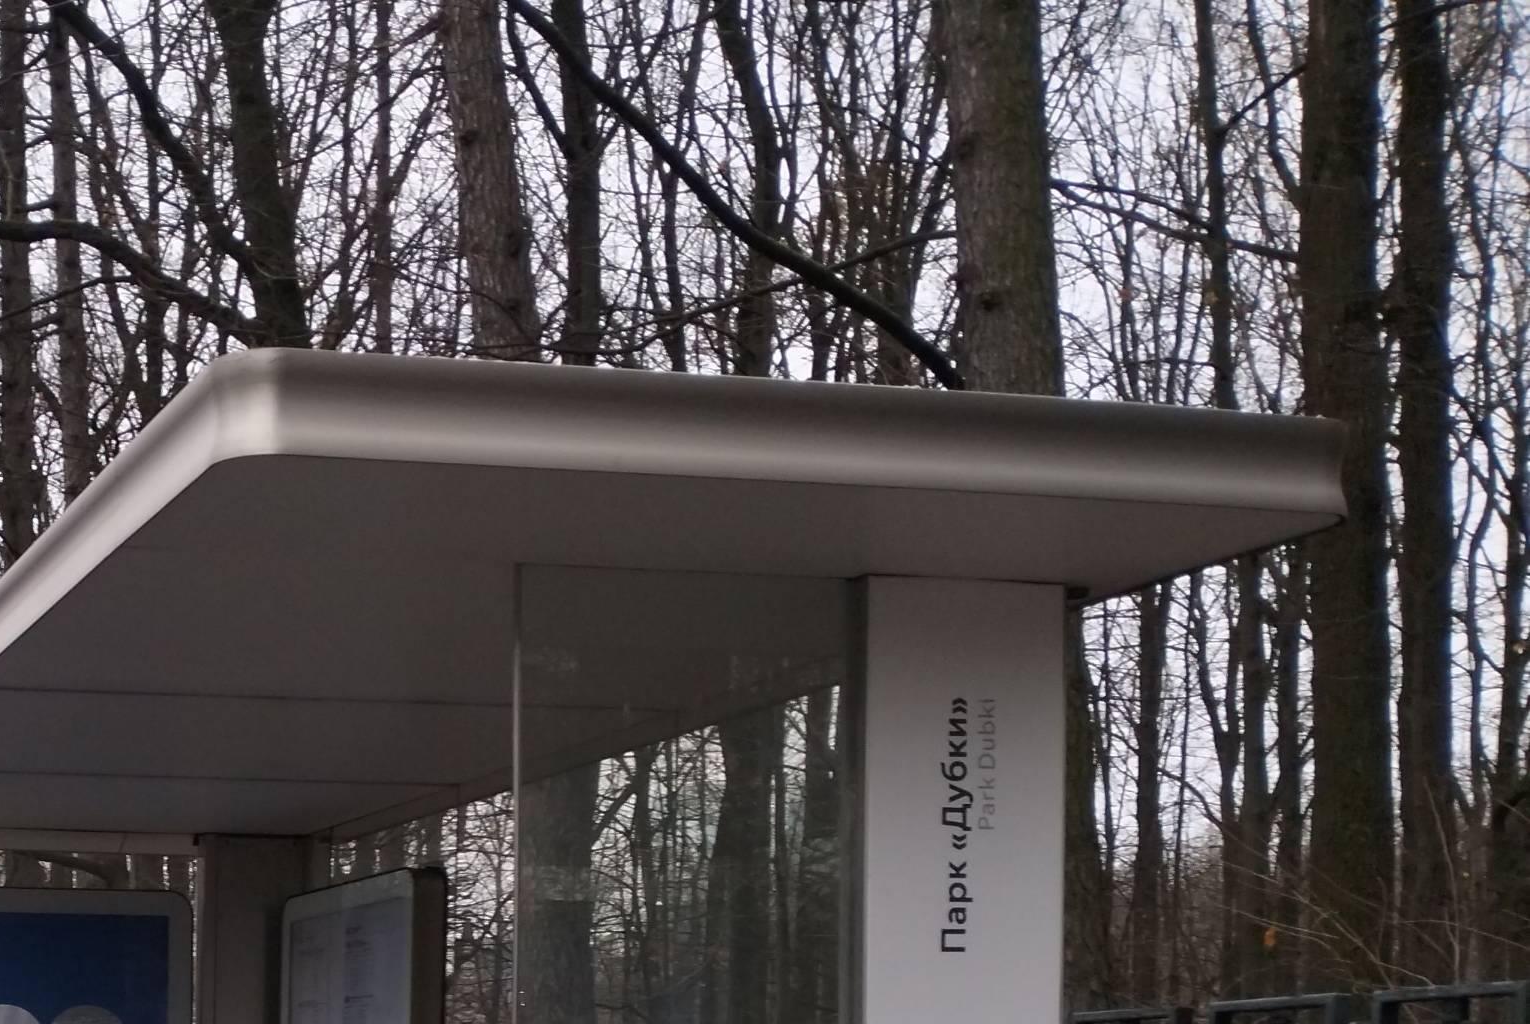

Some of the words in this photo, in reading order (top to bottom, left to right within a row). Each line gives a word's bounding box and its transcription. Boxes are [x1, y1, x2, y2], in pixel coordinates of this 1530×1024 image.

[940, 696, 973, 851] «Дубки»
[978, 698, 996, 770] Dubki
[978, 777, 996, 831] Park
[940, 861, 973, 953] Парк
